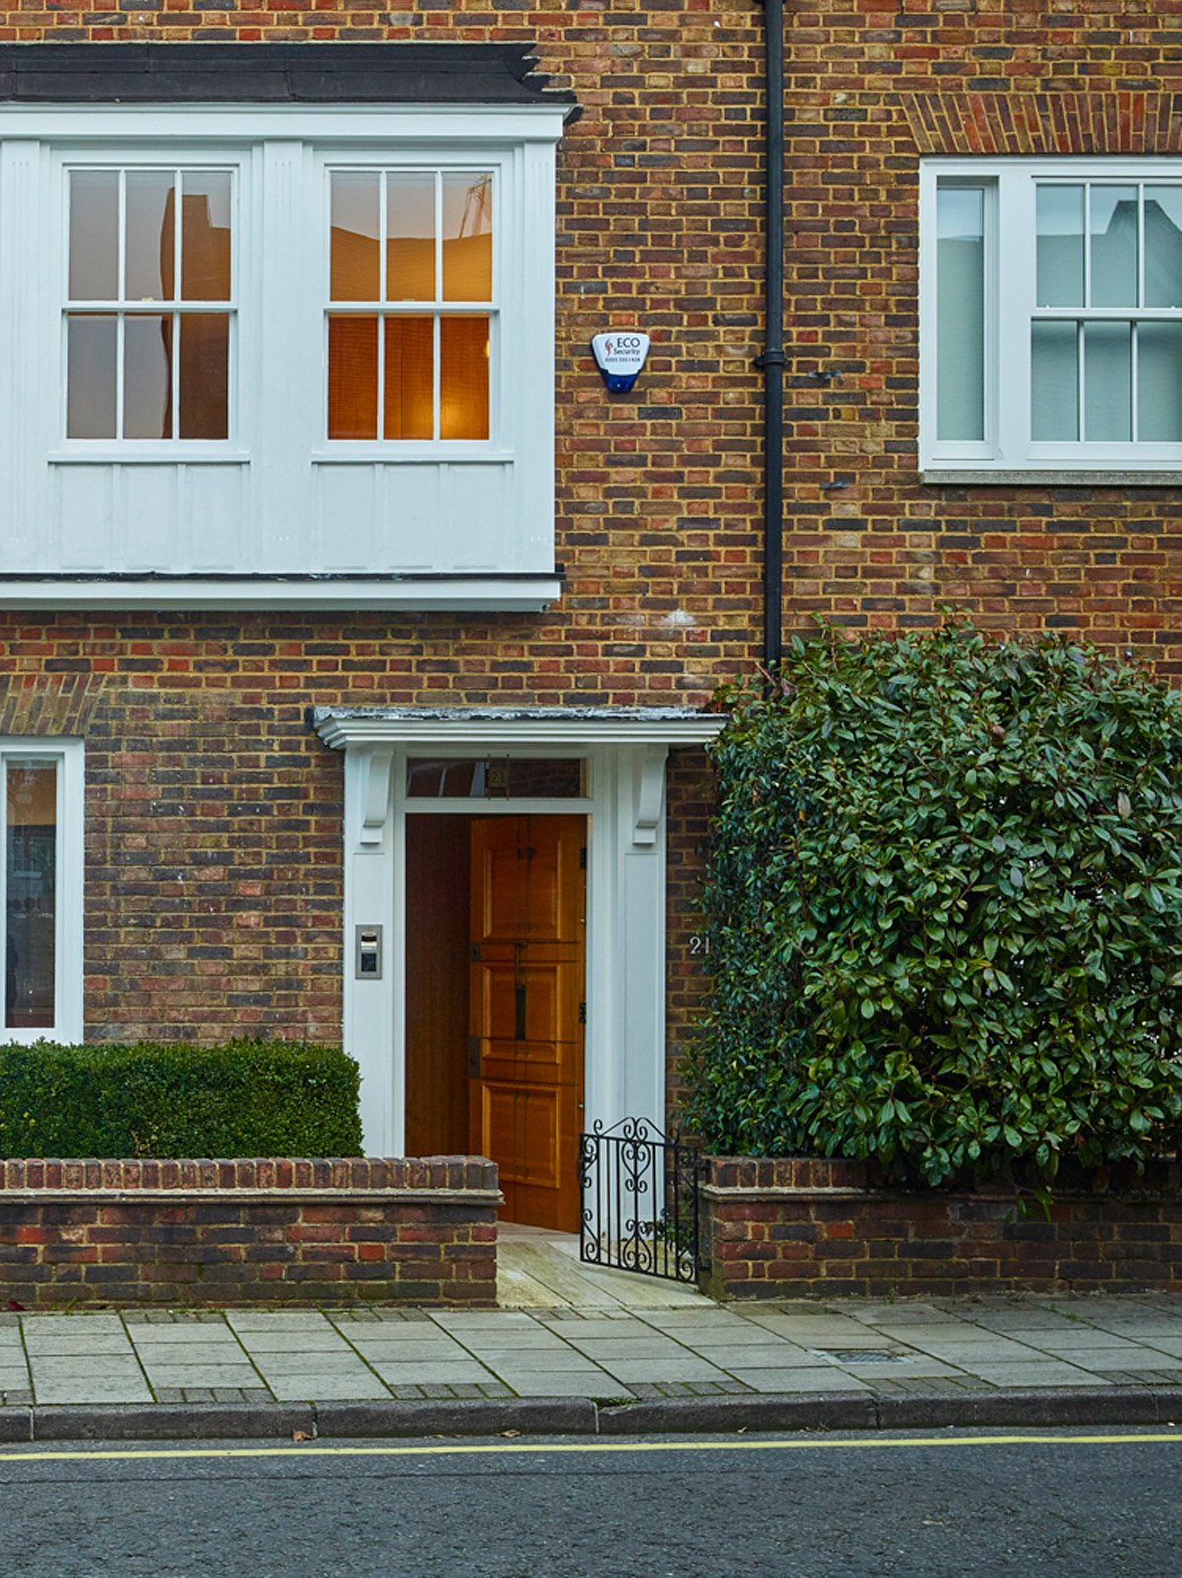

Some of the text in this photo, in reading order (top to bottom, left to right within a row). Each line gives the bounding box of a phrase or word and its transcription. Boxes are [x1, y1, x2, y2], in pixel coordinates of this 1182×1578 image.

[617, 337, 641, 348] ECO
[614, 348, 640, 356] Security
[491, 770, 506, 784] 21
[689, 936, 710, 954] 21
